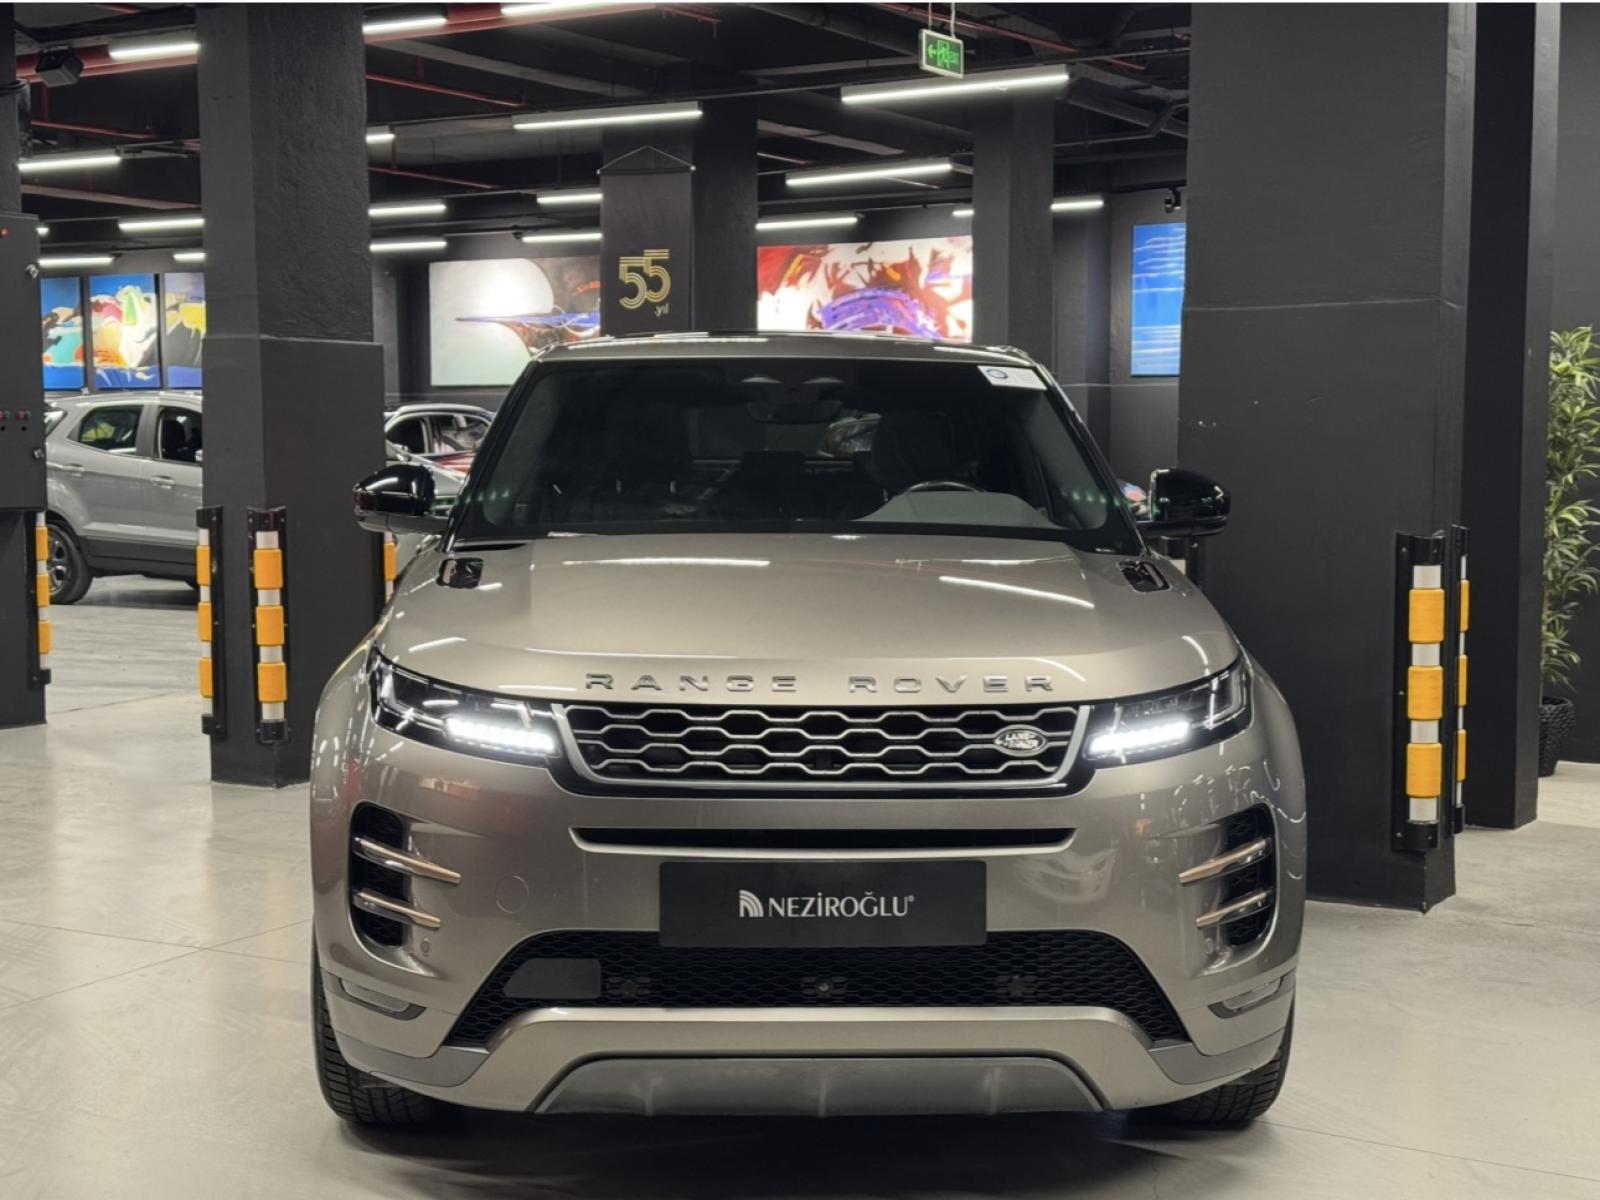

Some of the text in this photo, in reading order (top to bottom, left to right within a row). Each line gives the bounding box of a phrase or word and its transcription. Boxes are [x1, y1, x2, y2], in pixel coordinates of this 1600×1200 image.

[619, 249, 671, 309] 55
[585, 673, 1054, 693] RANGE ROVER
